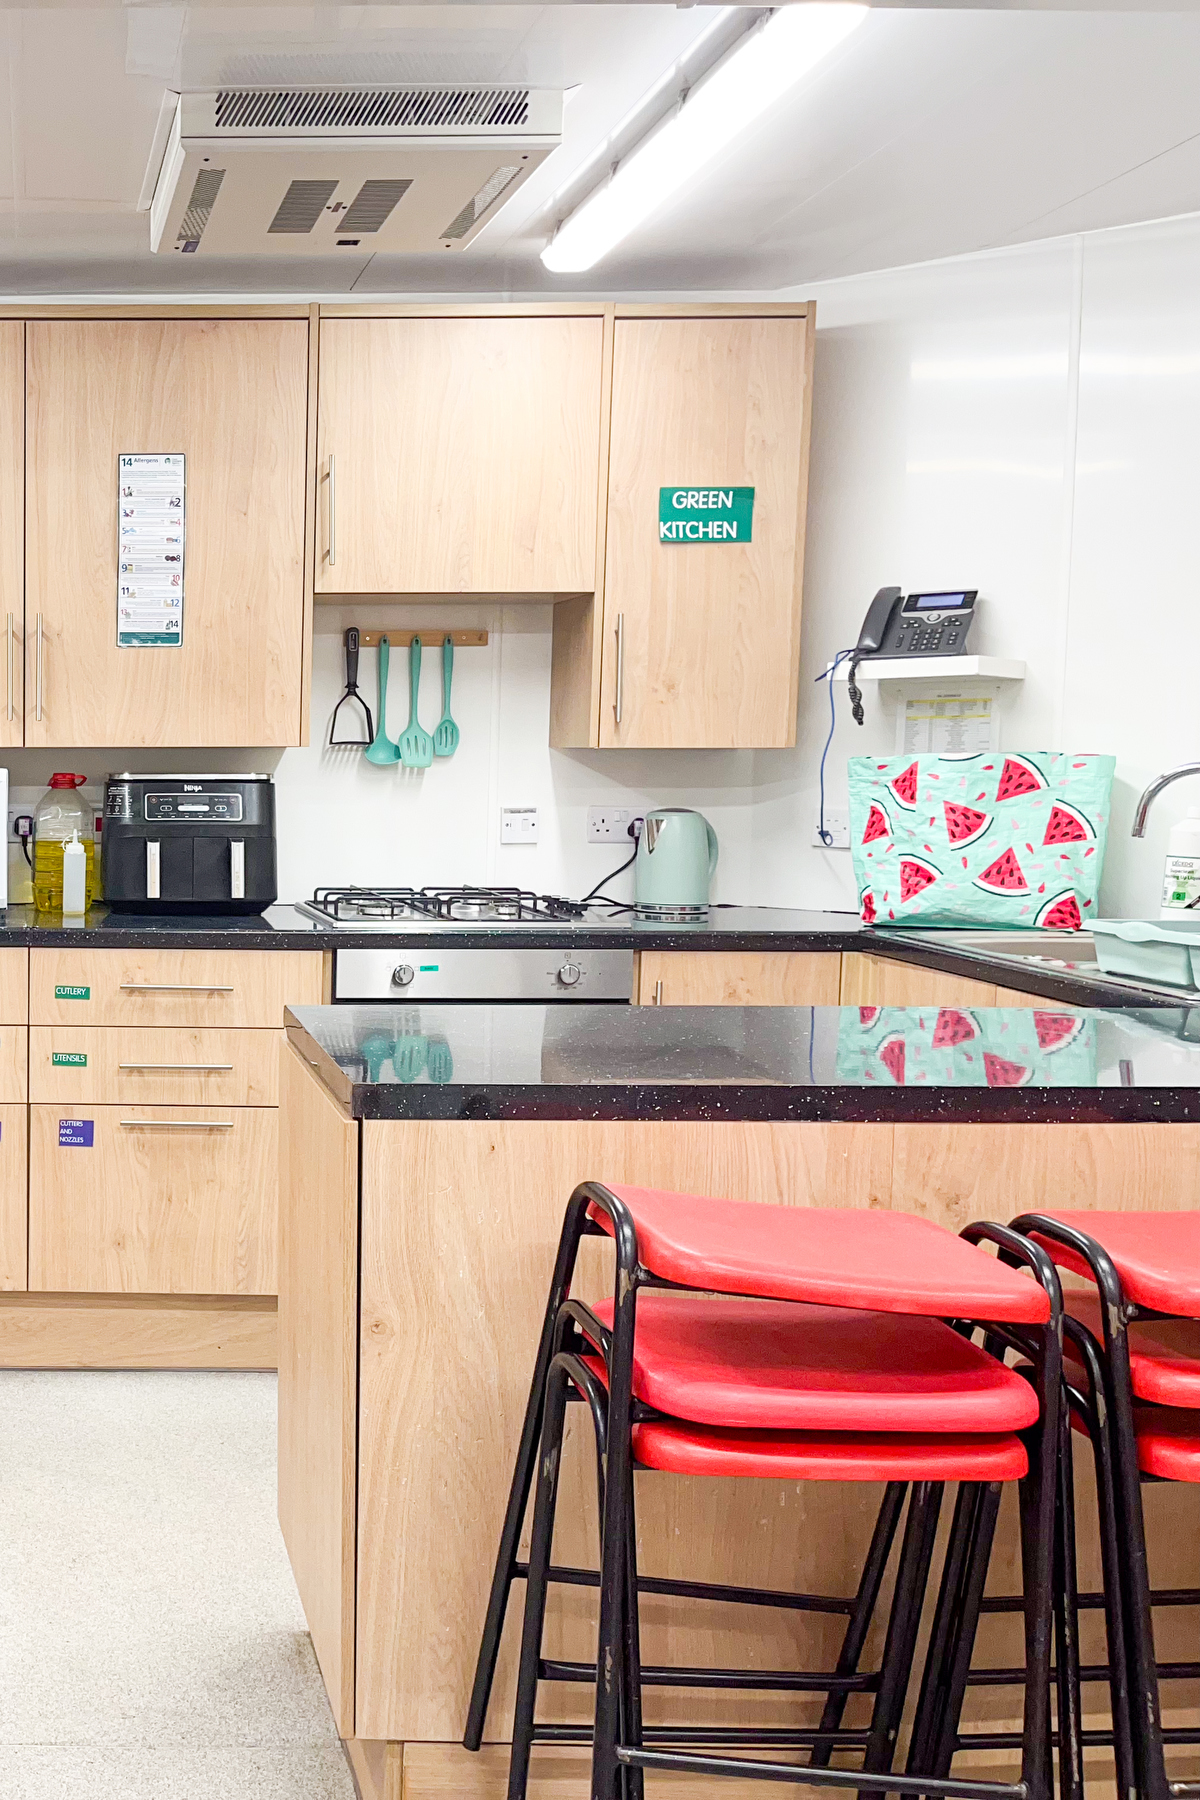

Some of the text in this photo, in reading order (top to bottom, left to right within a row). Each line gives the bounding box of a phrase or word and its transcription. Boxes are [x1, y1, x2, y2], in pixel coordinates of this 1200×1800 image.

[122, 458, 132, 467] 14
[174, 498, 182, 508] 2
[672, 490, 734, 509] GREEN
[659, 520, 738, 538] KITCHEN
[122, 564, 128, 572] 9
[172, 574, 180, 582] 10
[121, 587, 130, 596] 11
[170, 598, 180, 608] 12
[120, 608, 128, 616] 13
[170, 620, 179, 628] 14
[56, 987, 86, 996] CUTLERY
[53, 1054, 85, 1062] UTENSILS
